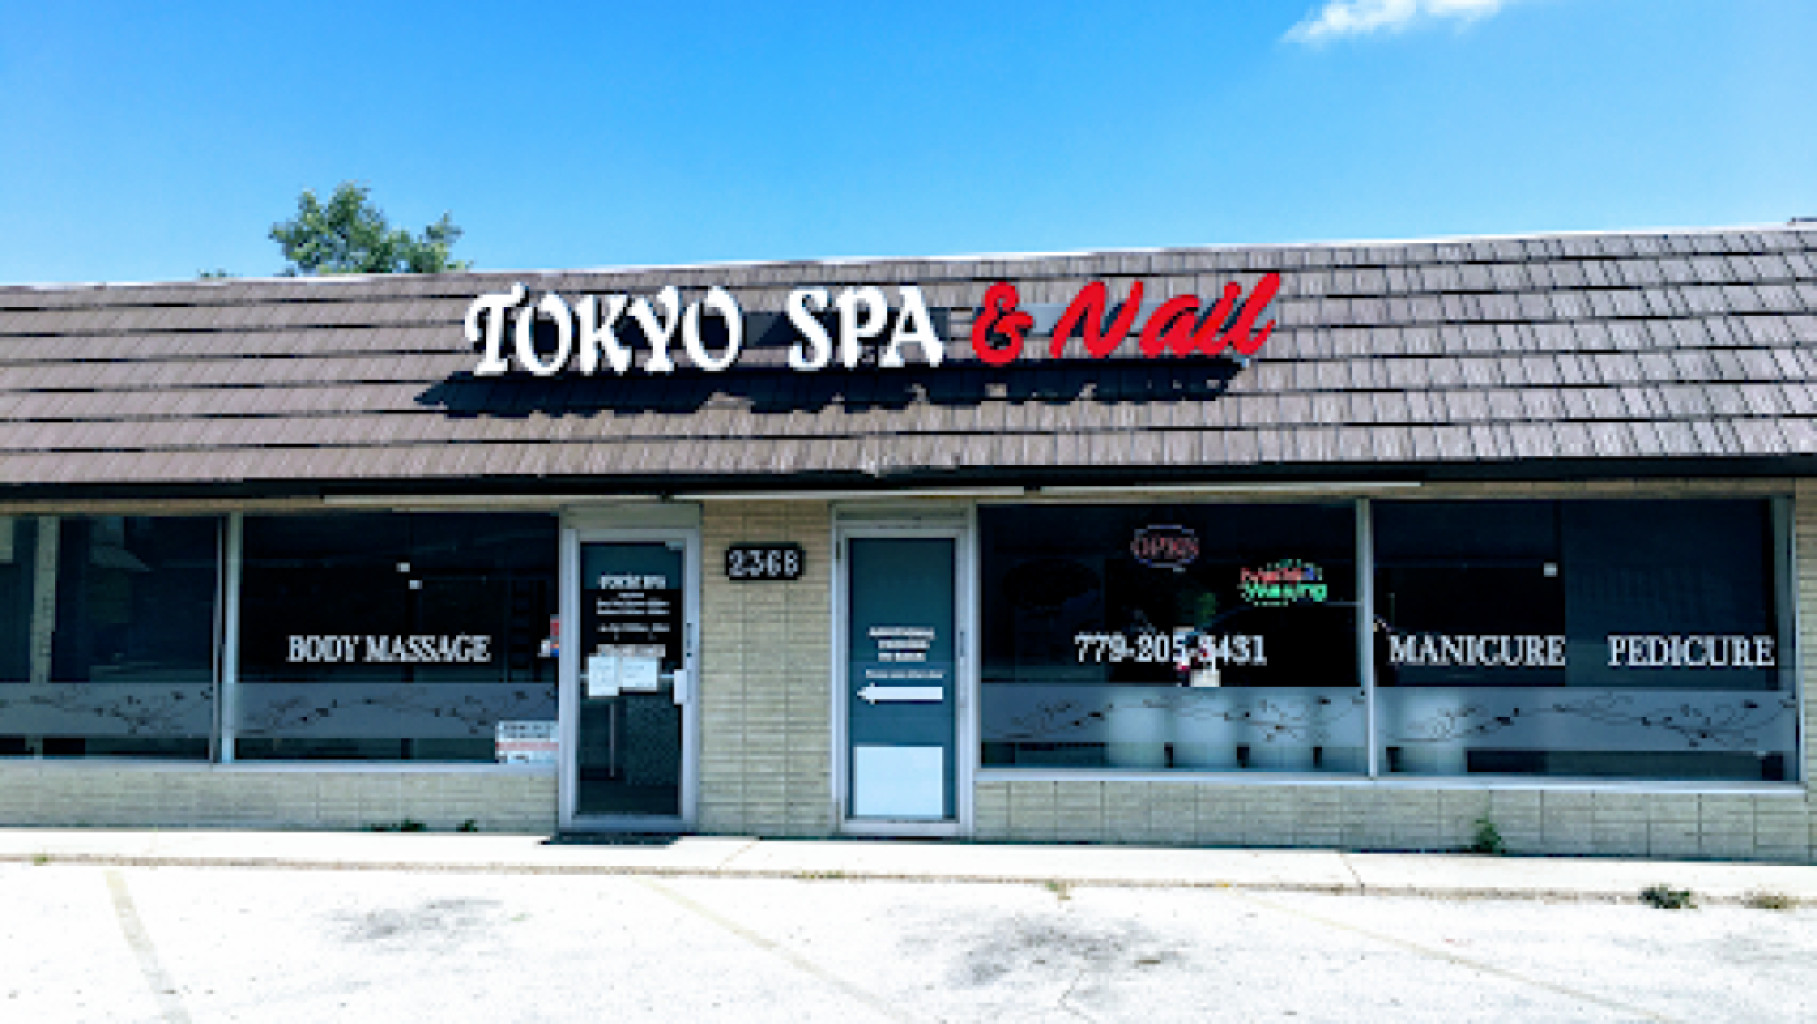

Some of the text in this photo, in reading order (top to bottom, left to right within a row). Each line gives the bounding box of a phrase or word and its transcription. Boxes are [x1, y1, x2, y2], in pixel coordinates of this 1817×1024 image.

[464, 271, 1280, 377] TOKYO SPA & Nail
[286, 634, 492, 663] BODY MASSAGE
[1388, 634, 1775, 668] MANICURE PEDICURE
